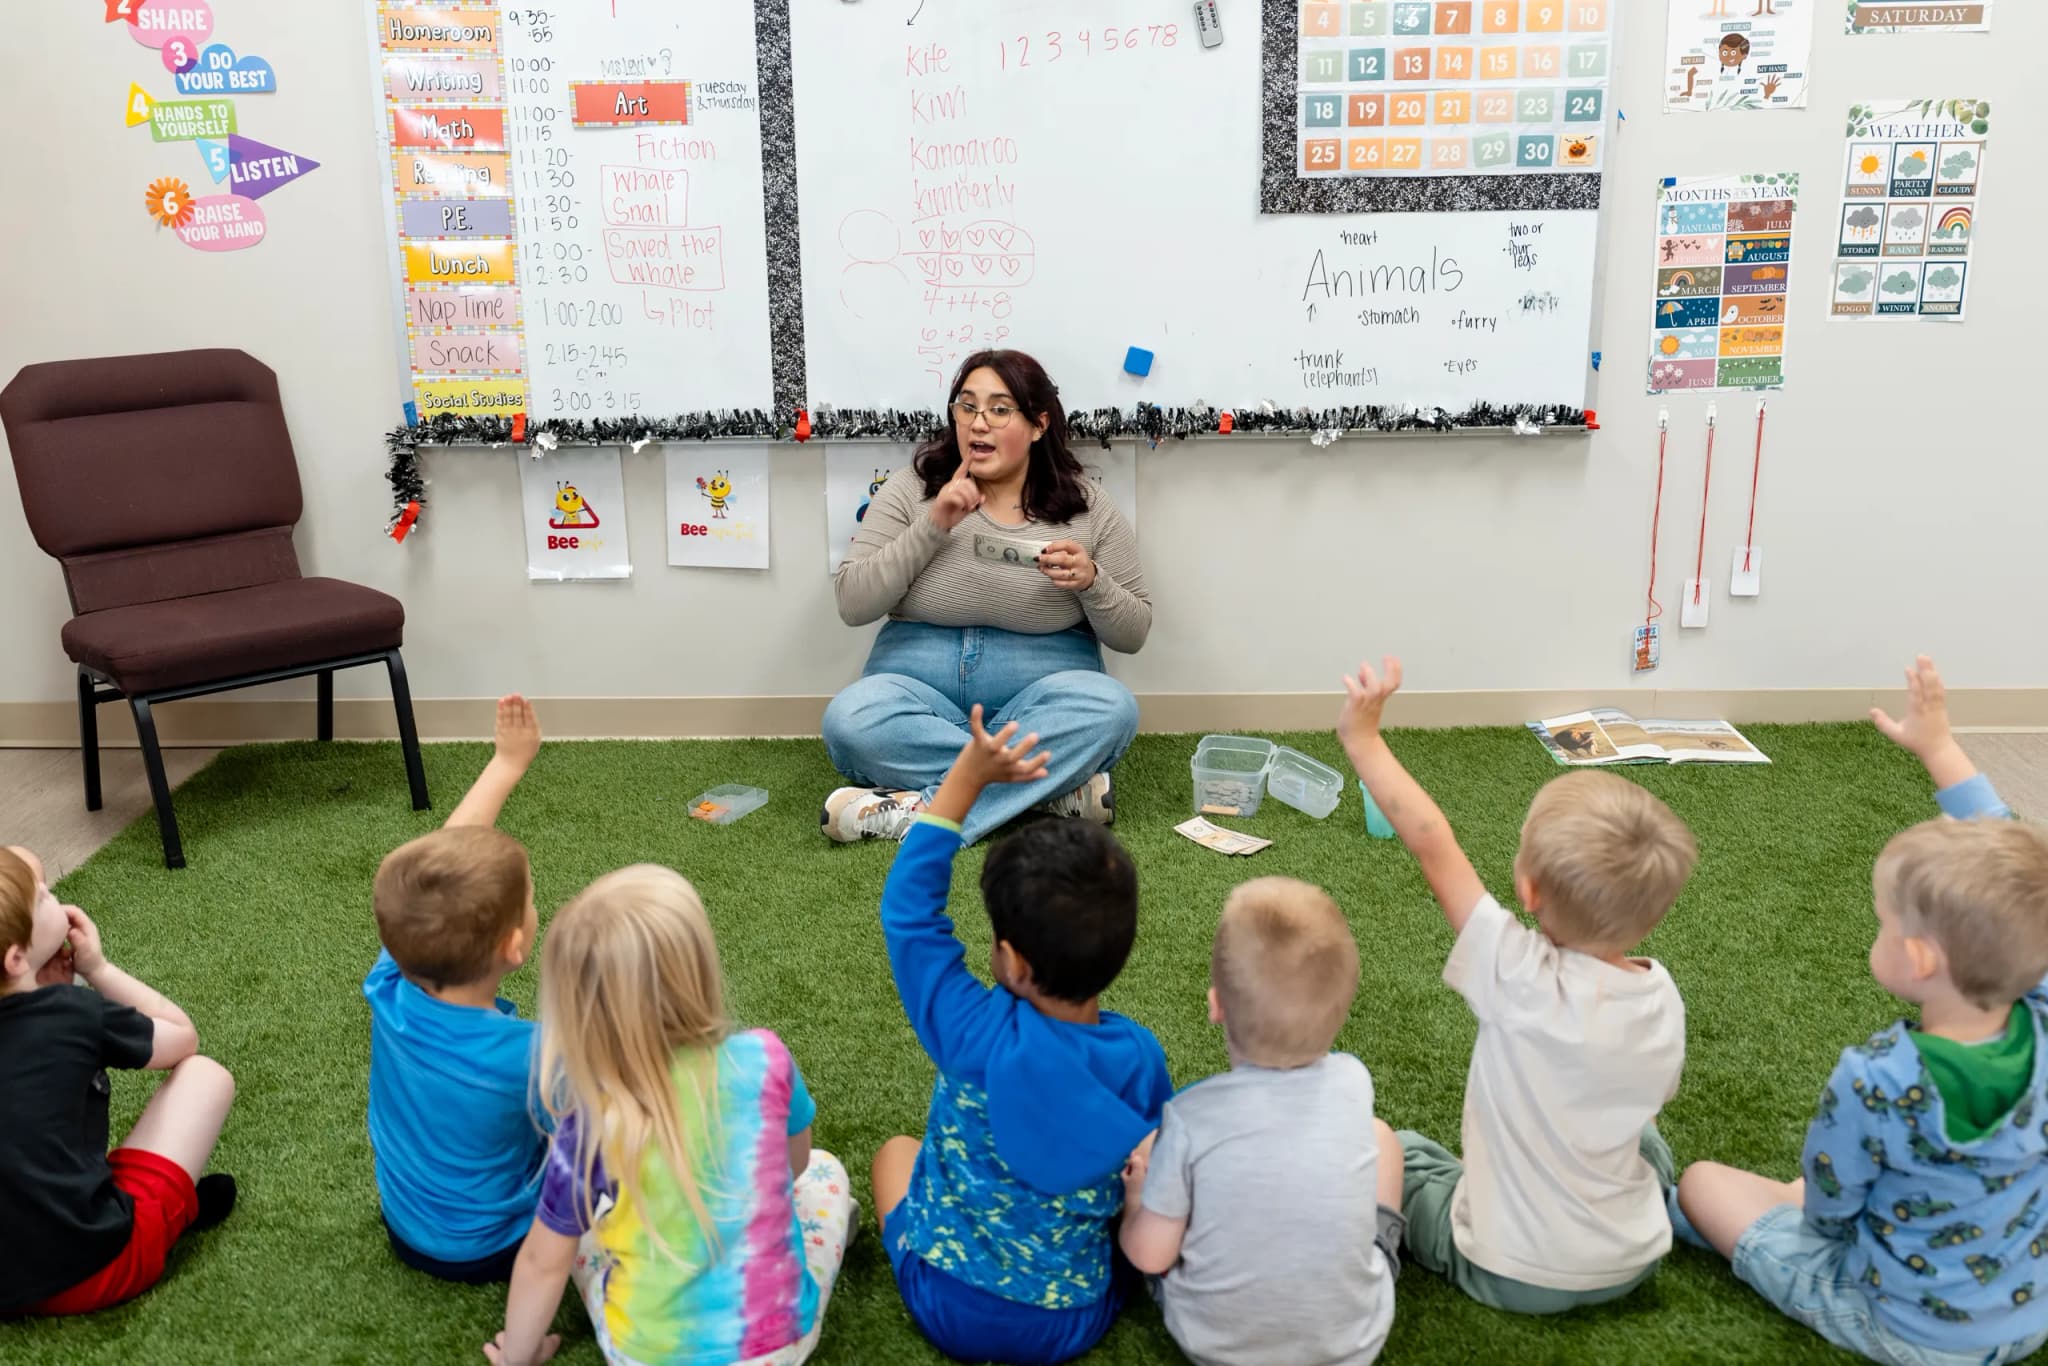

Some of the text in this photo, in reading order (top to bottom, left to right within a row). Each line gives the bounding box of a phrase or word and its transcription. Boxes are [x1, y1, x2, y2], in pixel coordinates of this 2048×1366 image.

[138, 9, 207, 31] SHARE
[1317, 10, 1329, 28] 4
[1363, 10, 1375, 28] 5
[1446, 9, 1459, 28] 7
[1494, 8, 1507, 26] 8
[1540, 7, 1552, 25] 9
[1578, 7, 1599, 25] 10
[1870, 8, 1968, 23] SATURDAY
[390, 17, 492, 42] Homeroom
[170, 42, 189, 67] 3
[1000, 23, 1178, 71] 1 2 3 4 5 6 7 8
[209, 52, 234, 70] DO
[1318, 52, 1599, 76] 11 12 13 14 15 16 17
[178, 70, 267, 91] YOUR BEST
[406, 66, 483, 94] Writing
[695, 80, 747, 95] Tuesday
[132, 93, 150, 117] 4
[153, 104, 229, 122] HANDS TO
[615, 89, 649, 116] Art
[1314, 97, 1596, 120] 18 19 20 21 22 23 24
[157, 120, 229, 137] YOURSELF
[421, 114, 475, 140] Math
[1869, 124, 1966, 139] WEATHER
[635, 133, 716, 162] Fiction
[1311, 140, 1549, 163] 25 26 27 28 29 30
[210, 148, 225, 172] 5
[230, 156, 299, 183] LISTEN
[910, 136, 1018, 184] Kangaroo
[1665, 188, 1732, 202] MONTHS
[1751, 186, 1790, 199] YEAR
[1850, 187, 1883, 195] SUNNY
[1894, 189, 1927, 197] SUNNY
[1939, 186, 1973, 194] CLOUDY
[163, 191, 179, 215] 6
[613, 193, 669, 224] Snail
[194, 203, 243, 225] RAISE
[441, 205, 473, 230] P.E.
[180, 221, 263, 243] YOUR HAND
[1510, 221, 1544, 238] two or
[1680, 223, 1724, 233] JANUARY
[1764, 220, 1792, 231] JULY
[608, 231, 716, 260] Saved the
[429, 251, 489, 275] Lunch
[1514, 253, 1538, 271] legs
[1748, 252, 1789, 262] AUGUST
[1302, 246, 1463, 301] Animals
[1681, 286, 1720, 296] MARCH
[1731, 283, 1787, 293] SEPTEMBER
[419, 294, 504, 325] Nap Time
[669, 297, 715, 331] Plot
[1837, 304, 1870, 313] FOGGY
[1882, 304, 1914, 312] WINDY
[1687, 317, 1718, 326] APRIL
[1738, 315, 1784, 324] OCTOBER
[430, 340, 499, 366] Snack
[1729, 345, 1781, 354] NOVEMBER
[1688, 377, 1714, 387] JUNE
[1728, 376, 1780, 385] DECEMBER
[424, 390, 523, 409] Social Studies
[681, 523, 708, 536] Bee
[547, 535, 579, 550] Bee
